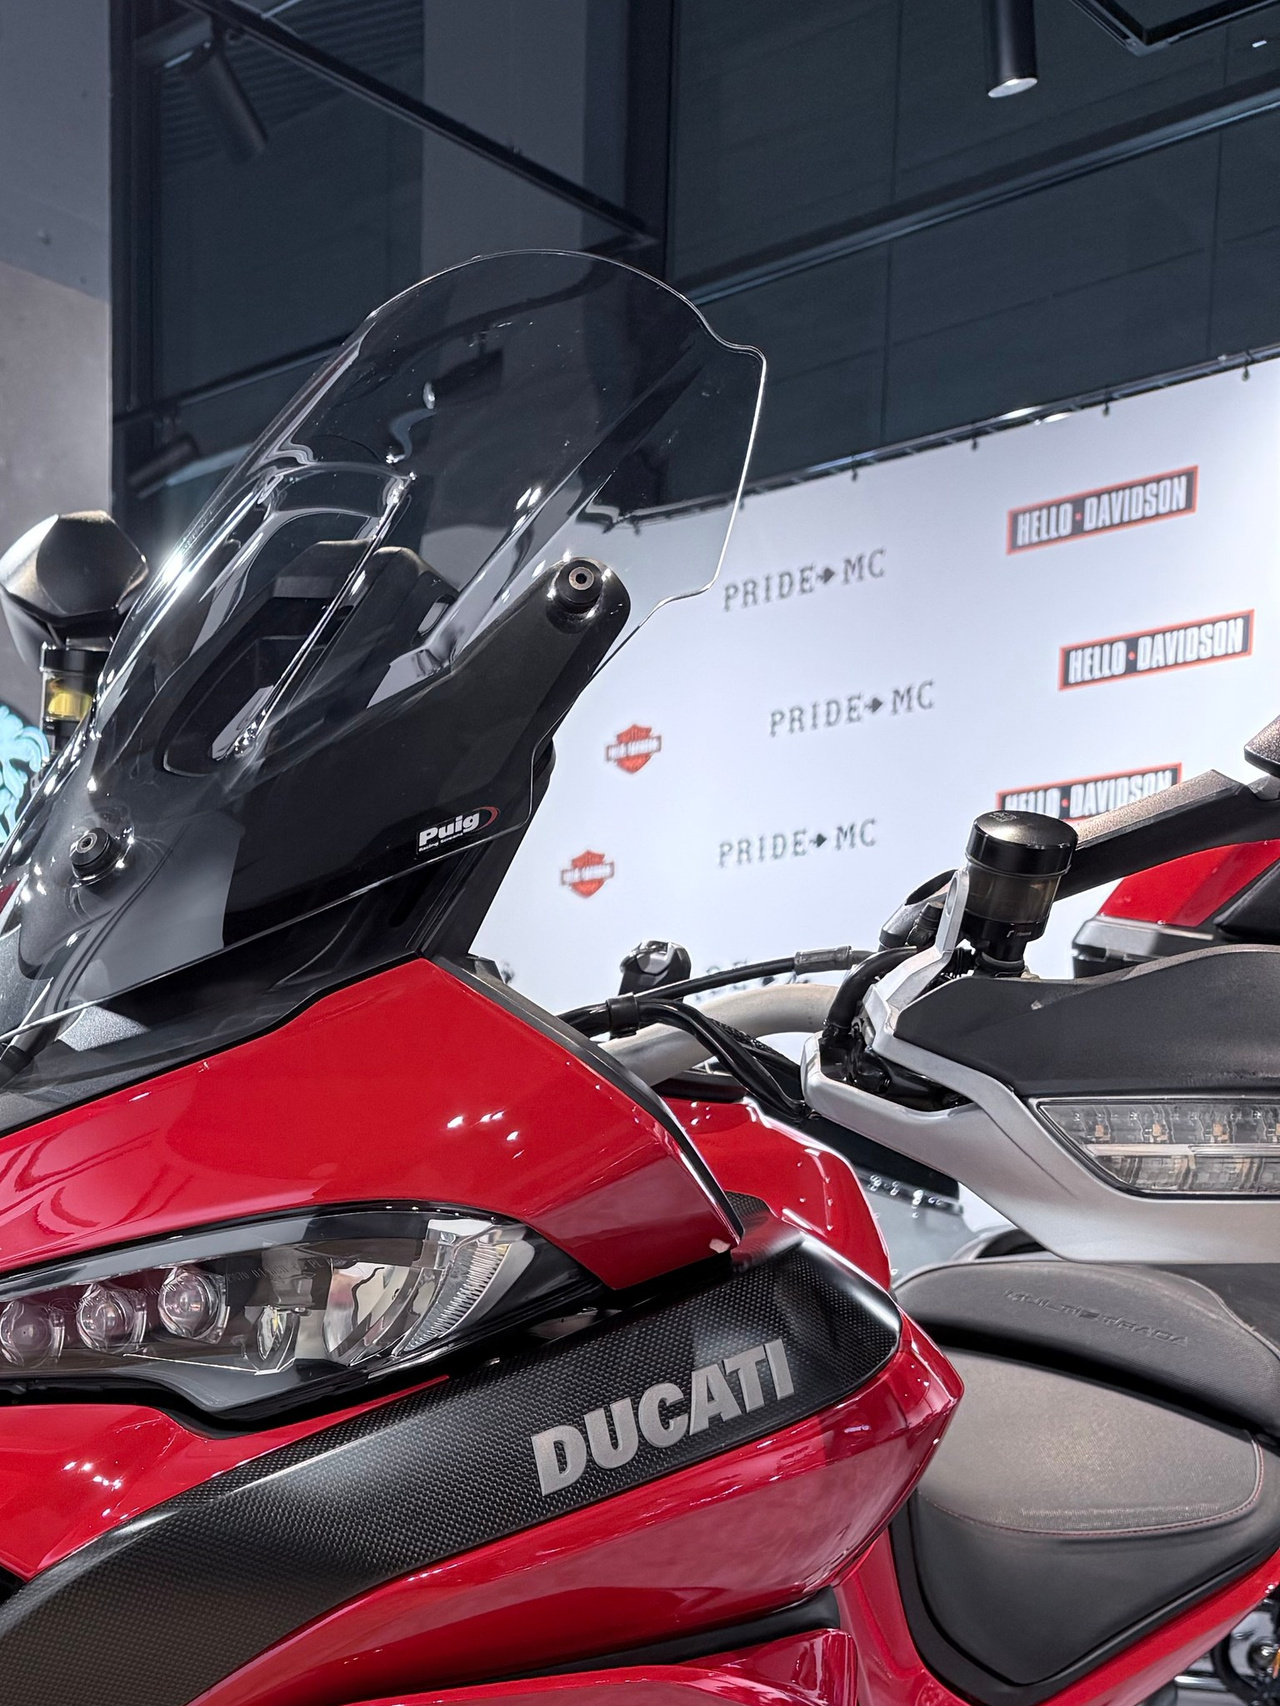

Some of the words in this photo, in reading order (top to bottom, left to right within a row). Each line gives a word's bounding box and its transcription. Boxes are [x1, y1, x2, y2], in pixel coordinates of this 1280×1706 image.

[1016, 503, 1073, 546] HELLO
[1083, 475, 1187, 531] DAVIDSON
[723, 563, 815, 612] PRIDE
[842, 549, 885, 585] MC
[1069, 641, 1127, 684] HELLO
[1136, 618, 1244, 671] DAVIDSON
[769, 693, 863, 737] PRIDE
[892, 679, 934, 715] MC
[419, 813, 480, 847] Puig
[718, 828, 808, 868] PRIDE
[835, 818, 877, 851] MC
[531, 1338, 796, 1497] DUCATI
